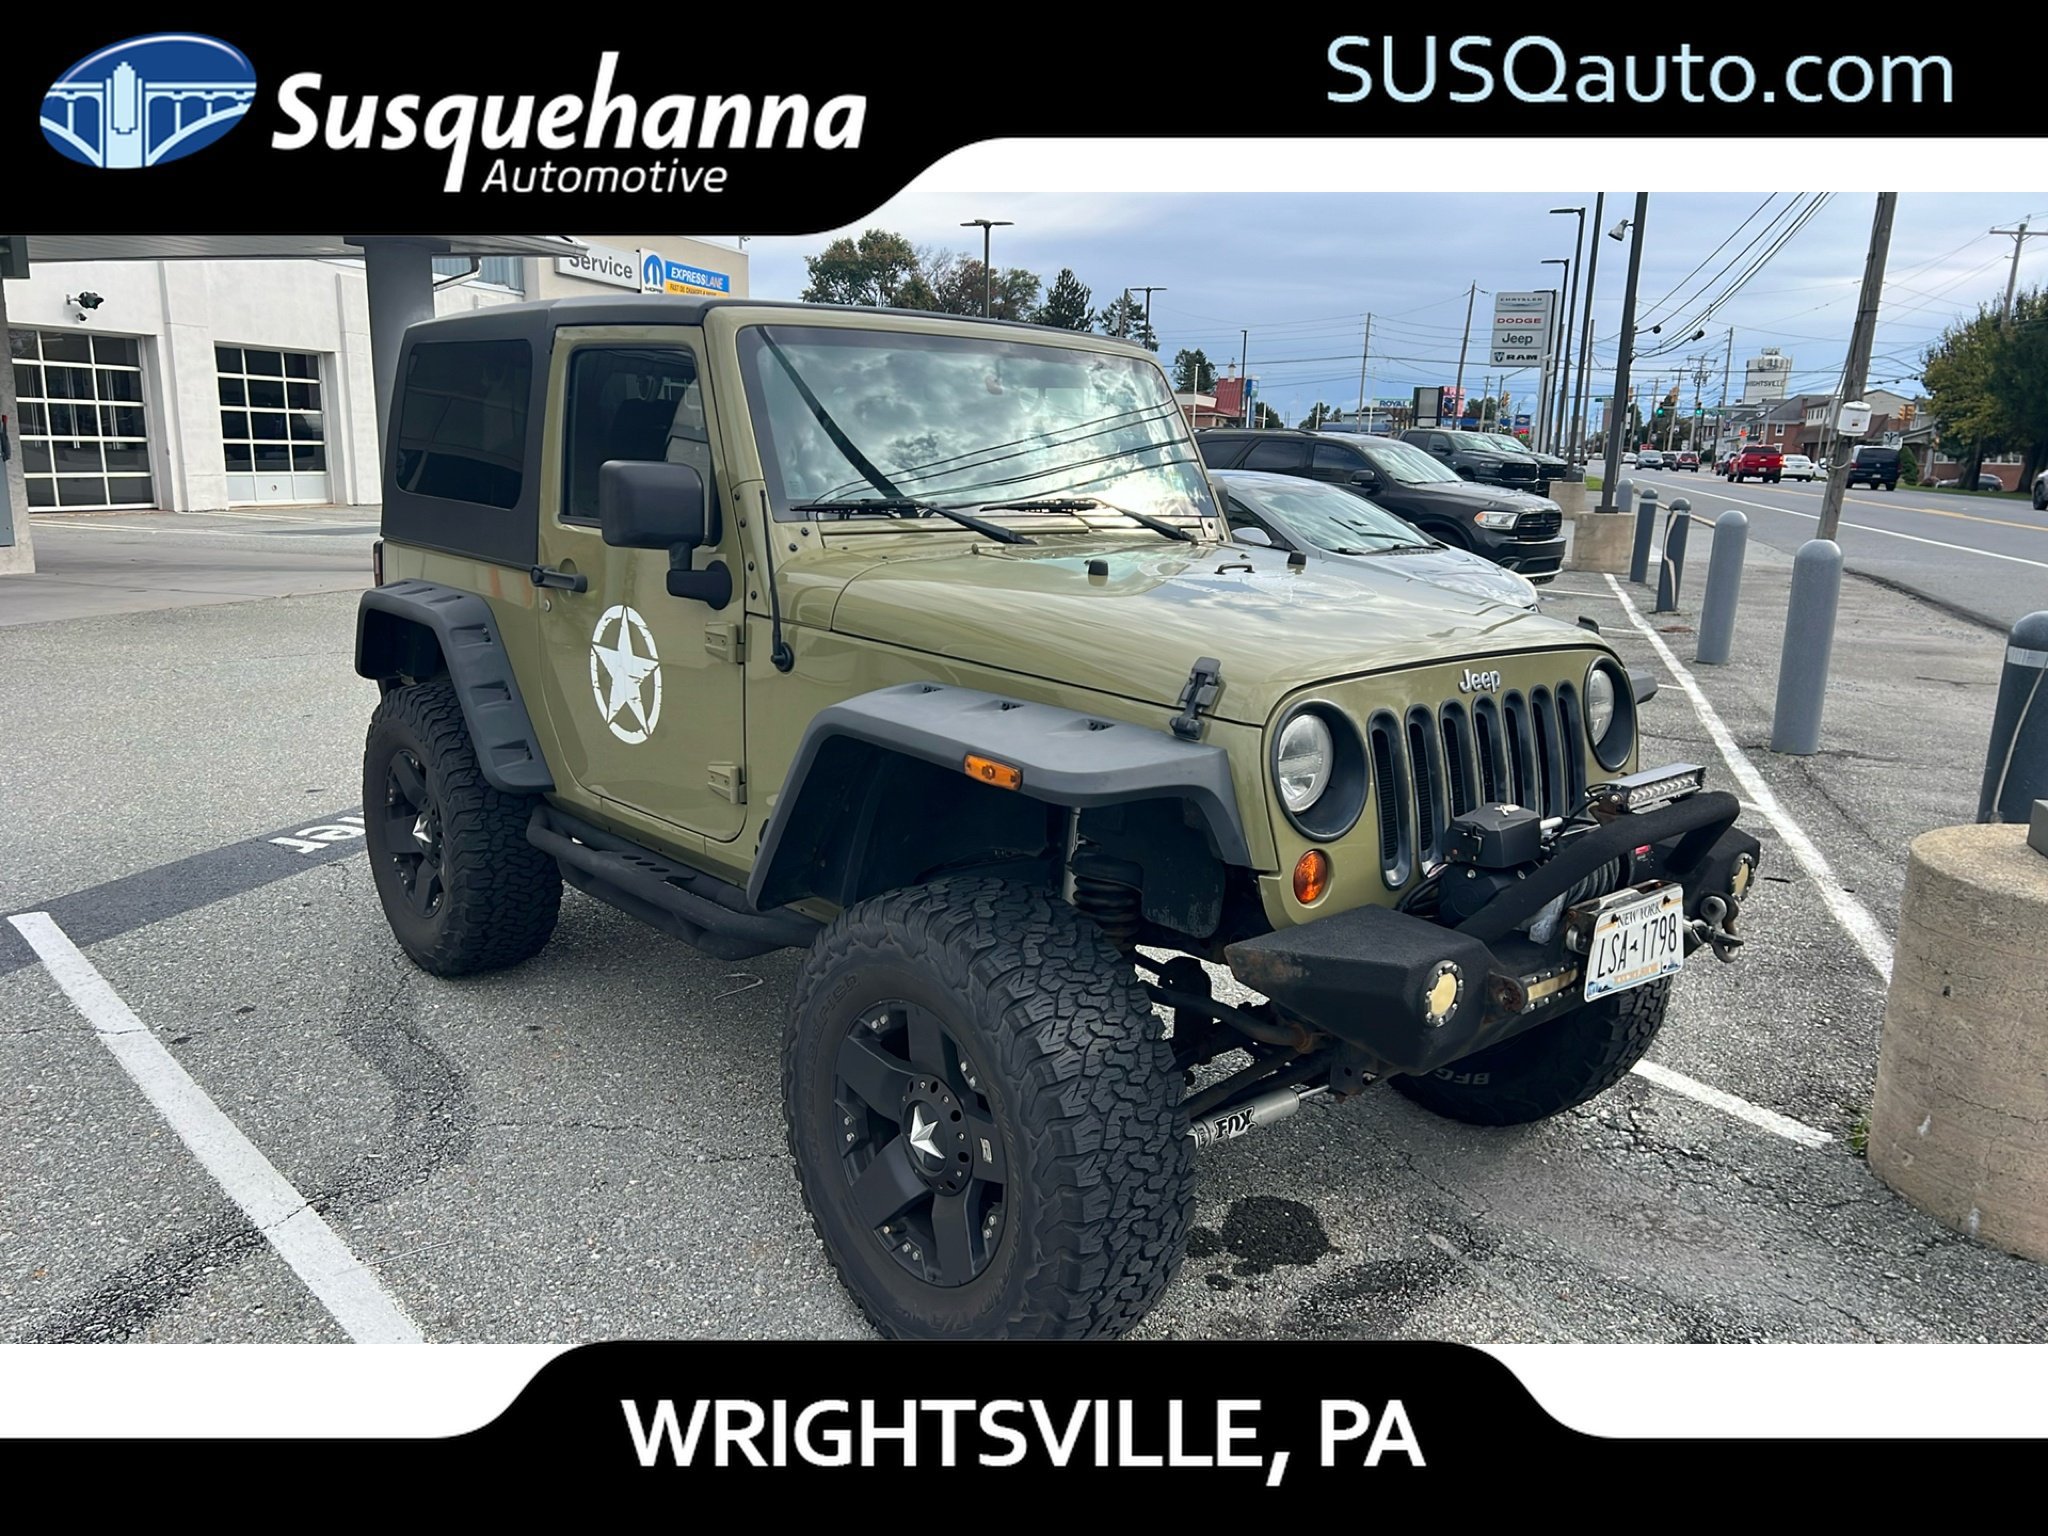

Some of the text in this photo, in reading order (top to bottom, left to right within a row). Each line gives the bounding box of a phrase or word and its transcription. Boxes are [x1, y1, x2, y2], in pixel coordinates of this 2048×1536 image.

[569, 255, 633, 280] Service
[1502, 333, 1533, 346] Jeep
[1459, 668, 1500, 693] Jeep
[1618, 901, 1661, 928] NEW YORK
[1214, 1106, 1257, 1140] FOX
